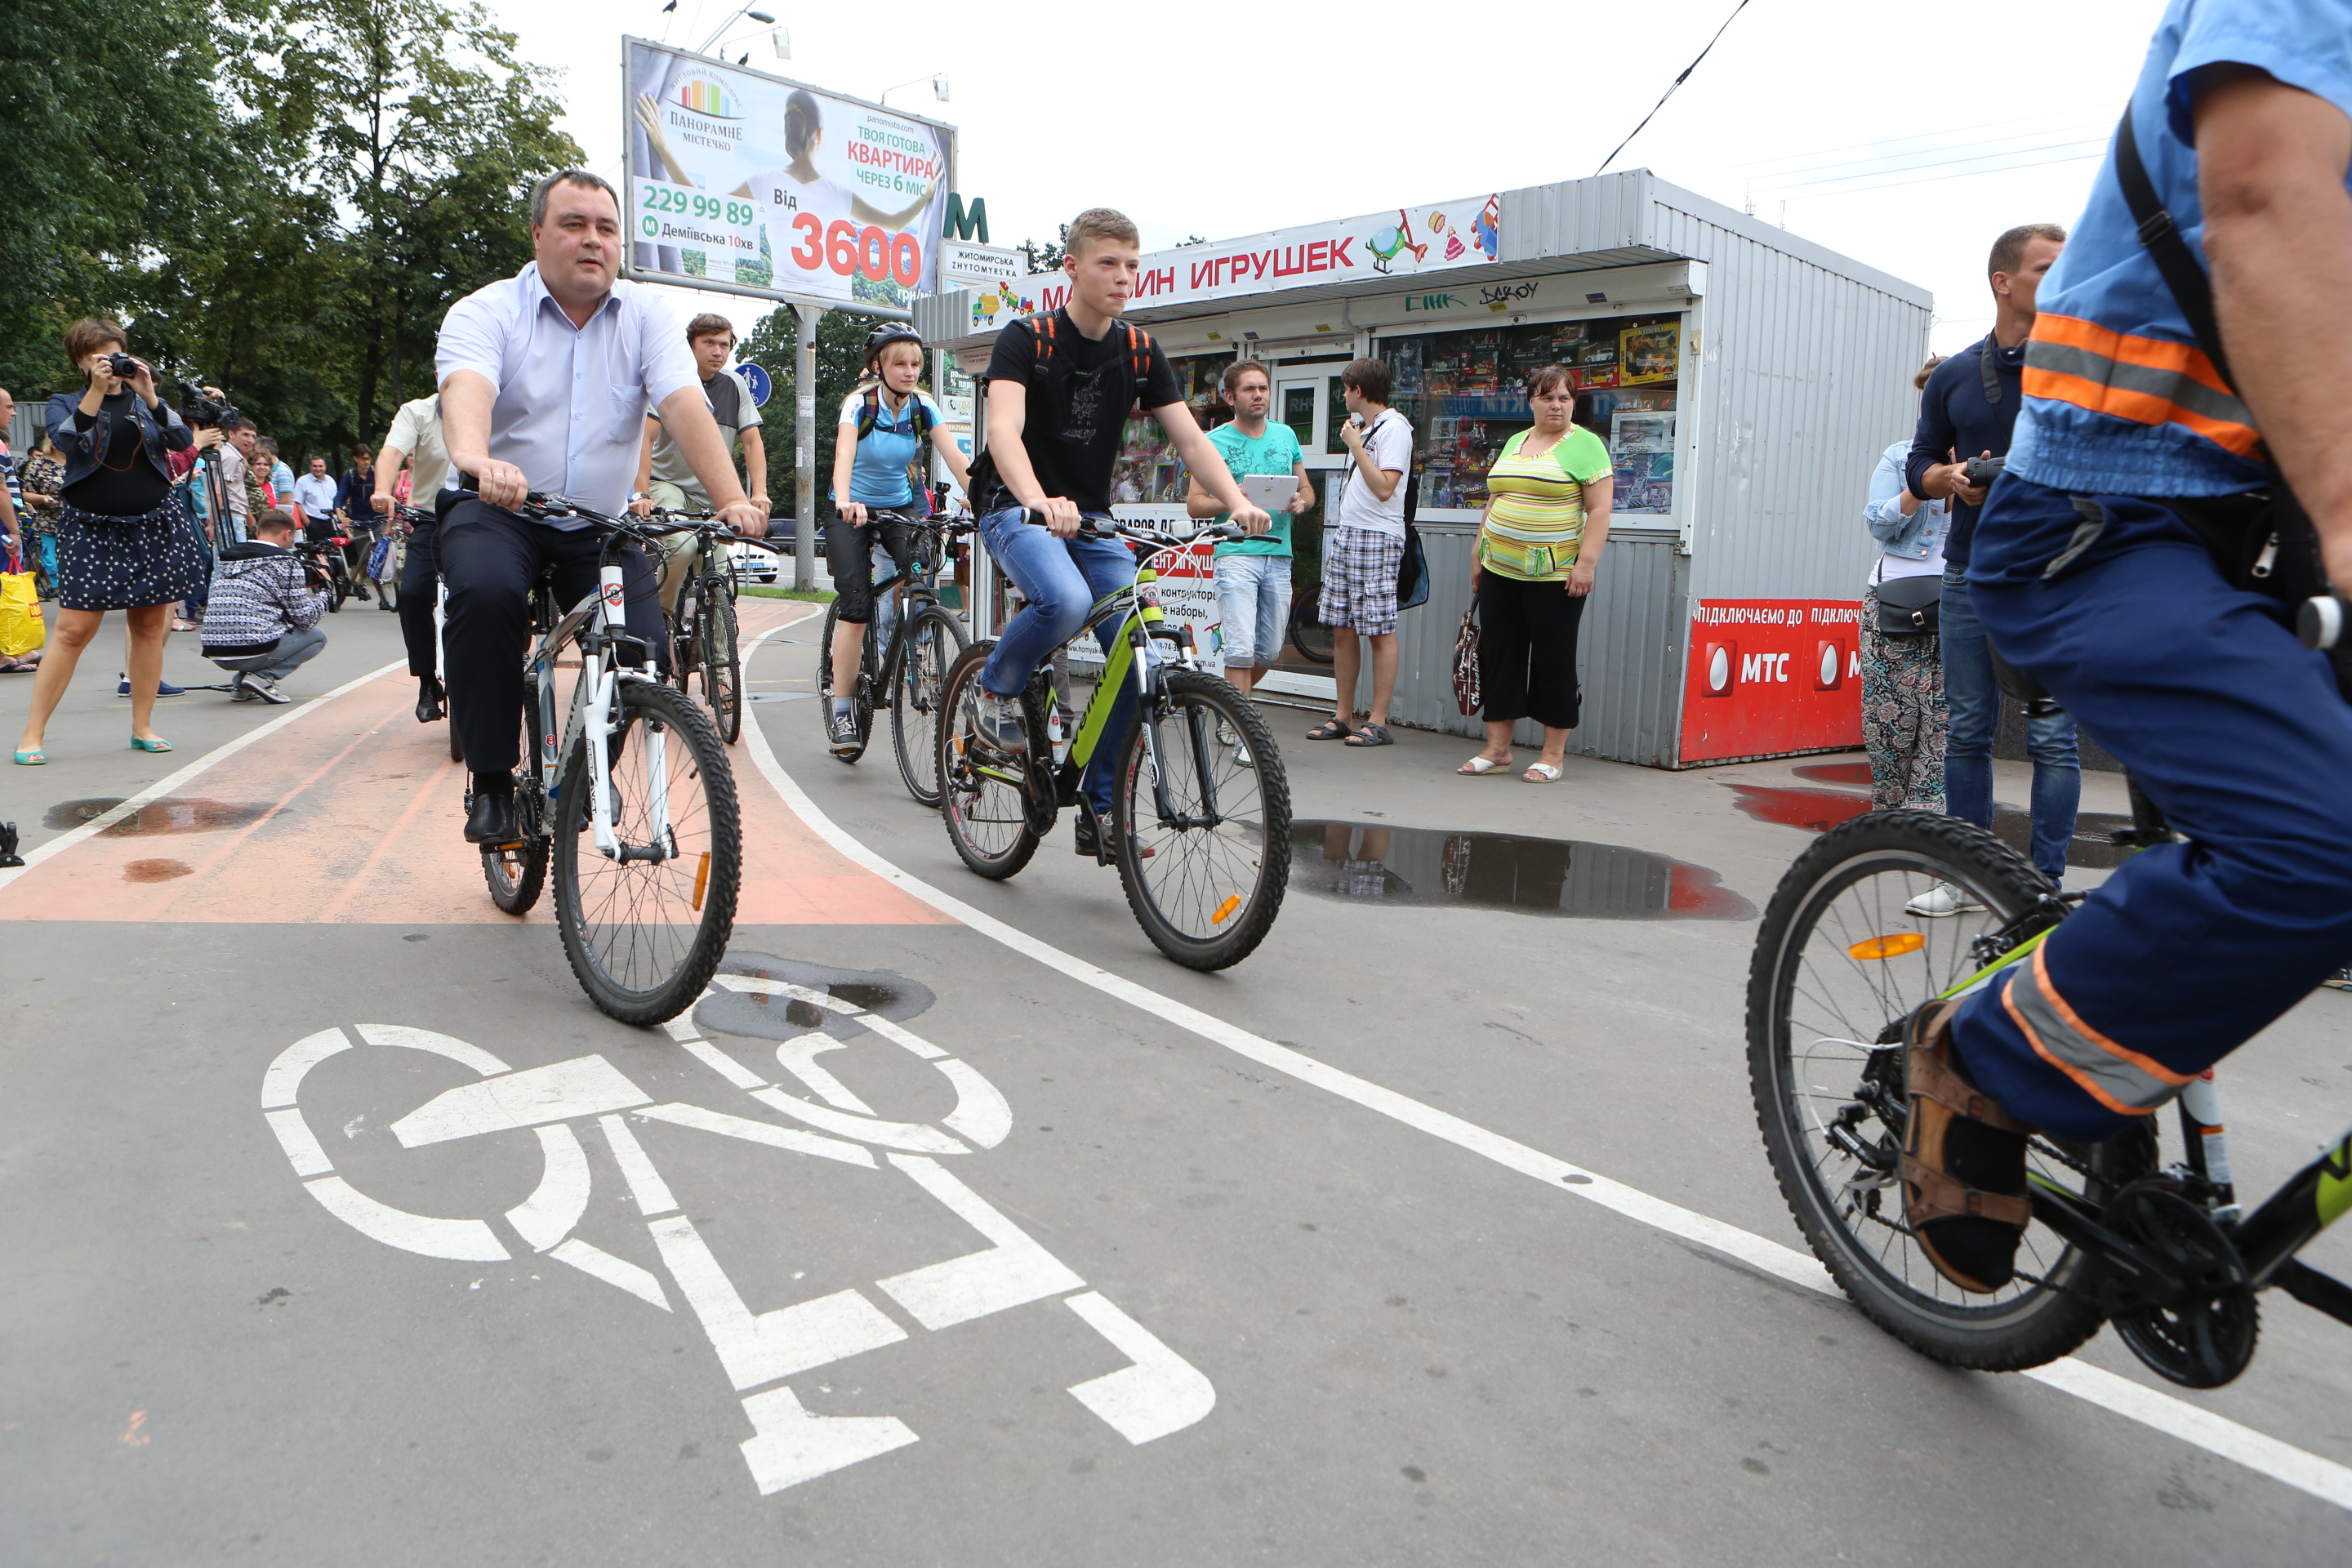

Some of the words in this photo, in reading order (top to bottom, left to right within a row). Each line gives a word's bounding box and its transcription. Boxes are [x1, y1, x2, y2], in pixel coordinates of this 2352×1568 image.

[670, 110, 742, 140] ПАНОРАМНЕ
[867, 115, 914, 134] panomisto.com
[683, 132, 731, 152] МІСТЕЧКО
[858, 126, 884, 144] ТВОЯ
[887, 134, 925, 155] ГОТОВА
[848, 140, 935, 180] КВАРТИРА
[857, 169, 891, 189] ЧЕРЕЗ
[893, 175, 903, 192] 6
[644, 185, 687, 213] 229
[693, 194, 721, 220] 99
[726, 202, 753, 226] 89
[774, 189, 797, 212] Від
[662, 223, 725, 245] Деміївська
[791, 212, 921, 287] 3600
[958, 251, 1013, 266] ЖИТОМИРСЬКА
[951, 261, 1017, 278] ZHYTOMYRS'KA
[1191, 236, 1355, 290] ИГРУШЕК
[1170, 604, 1209, 620] наборы,
[1698, 607, 1785, 626] ПІДКЛЮЧАЄМО
[1786, 609, 1803, 627] ДО
[1741, 653, 1790, 684] МТС
